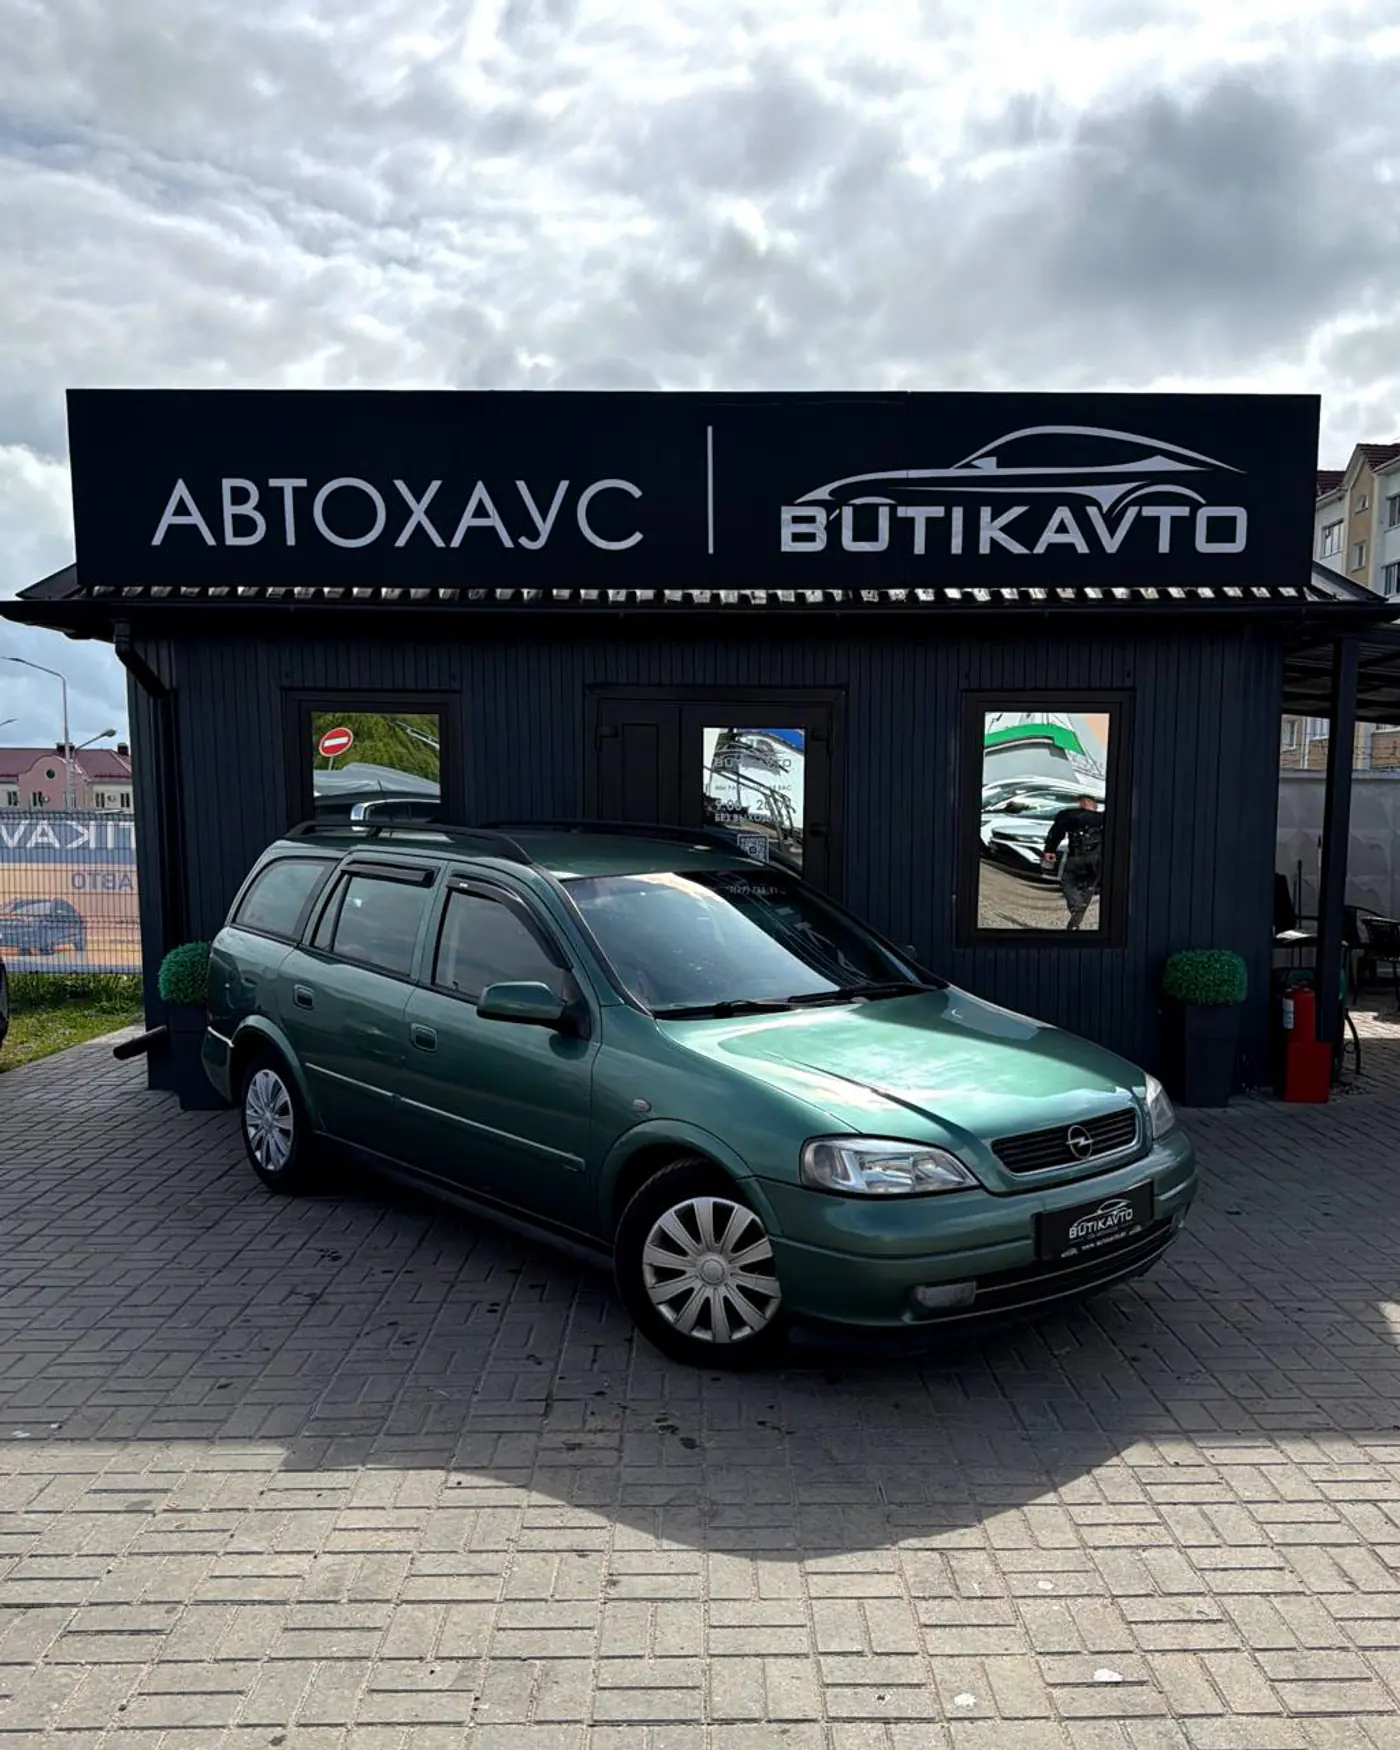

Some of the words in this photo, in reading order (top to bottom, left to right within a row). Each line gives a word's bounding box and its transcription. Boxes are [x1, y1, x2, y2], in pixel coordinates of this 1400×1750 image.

[151, 477, 645, 552] АВТОХАУС
[780, 503, 1247, 555] BUTIKAVTO
[1069, 1208, 1134, 1239] BUTIKAVTO
